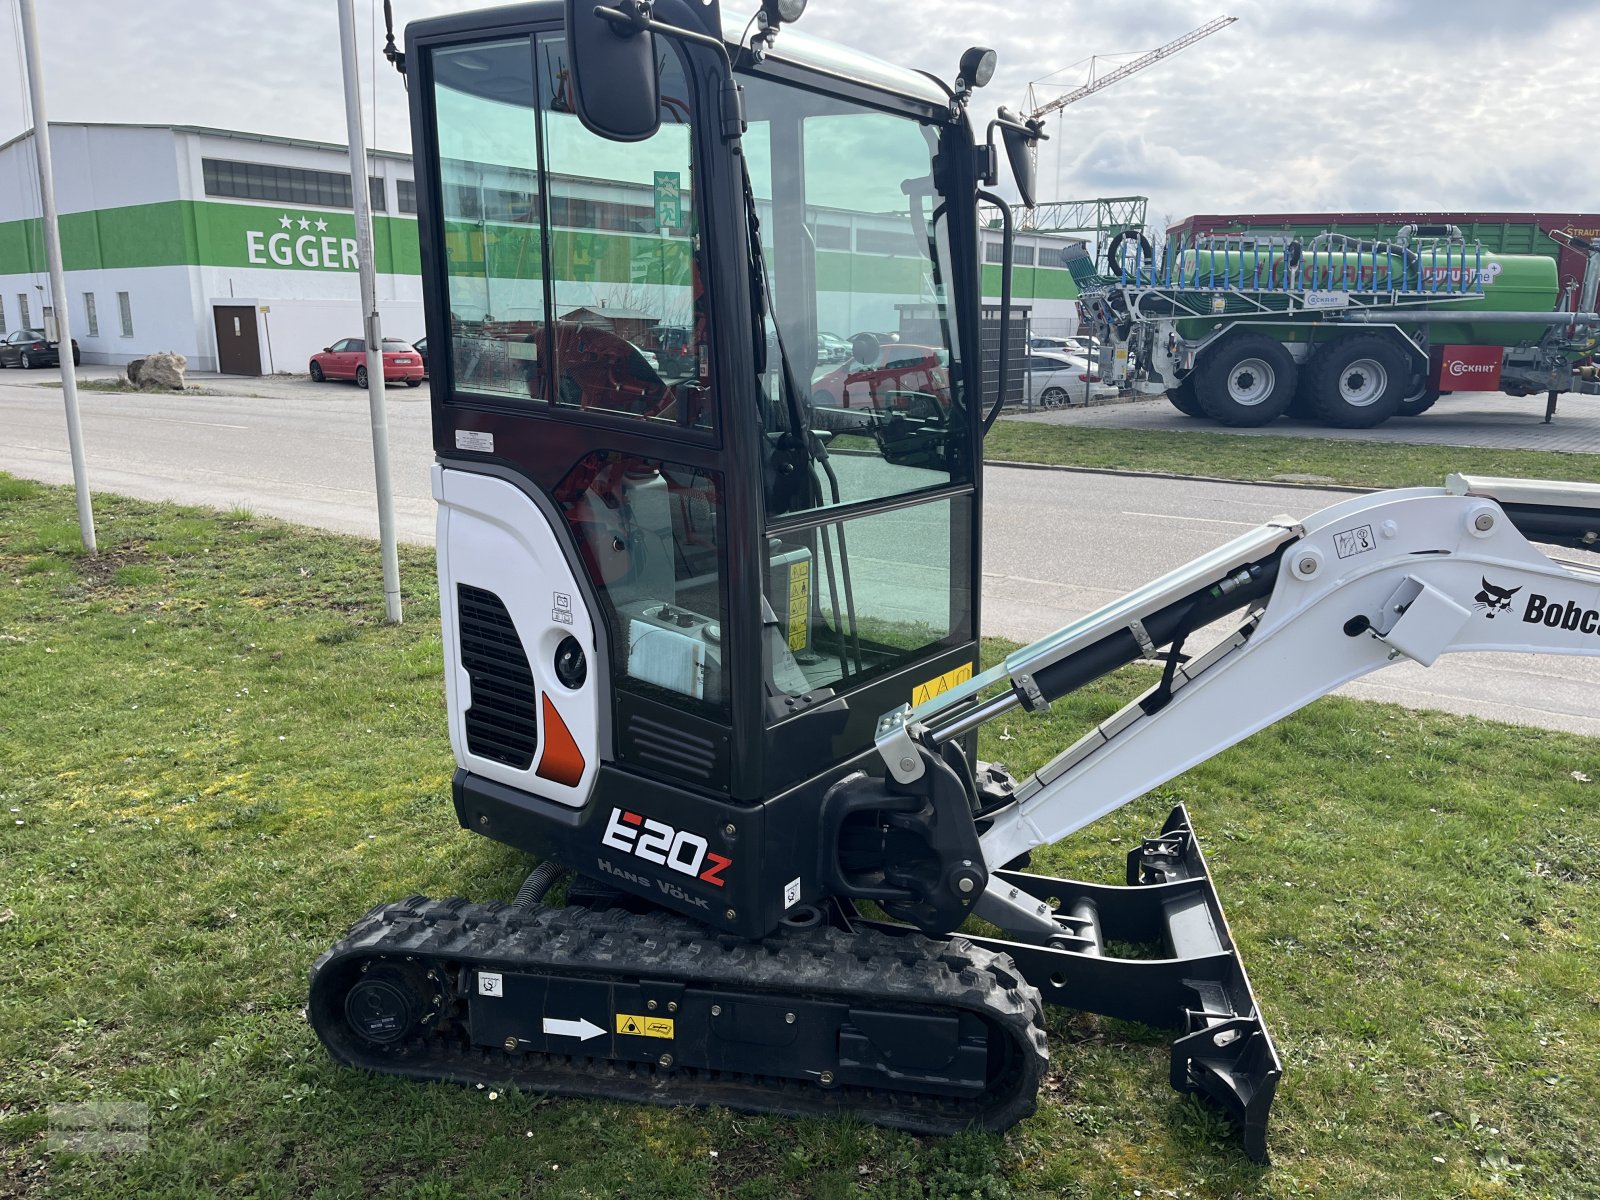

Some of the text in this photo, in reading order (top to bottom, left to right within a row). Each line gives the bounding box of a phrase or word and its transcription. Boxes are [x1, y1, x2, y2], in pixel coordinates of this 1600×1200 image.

[246, 230, 360, 270] EGGER
[1449, 360, 1495, 376] ECKART
[1522, 593, 1600, 636] Bobc
